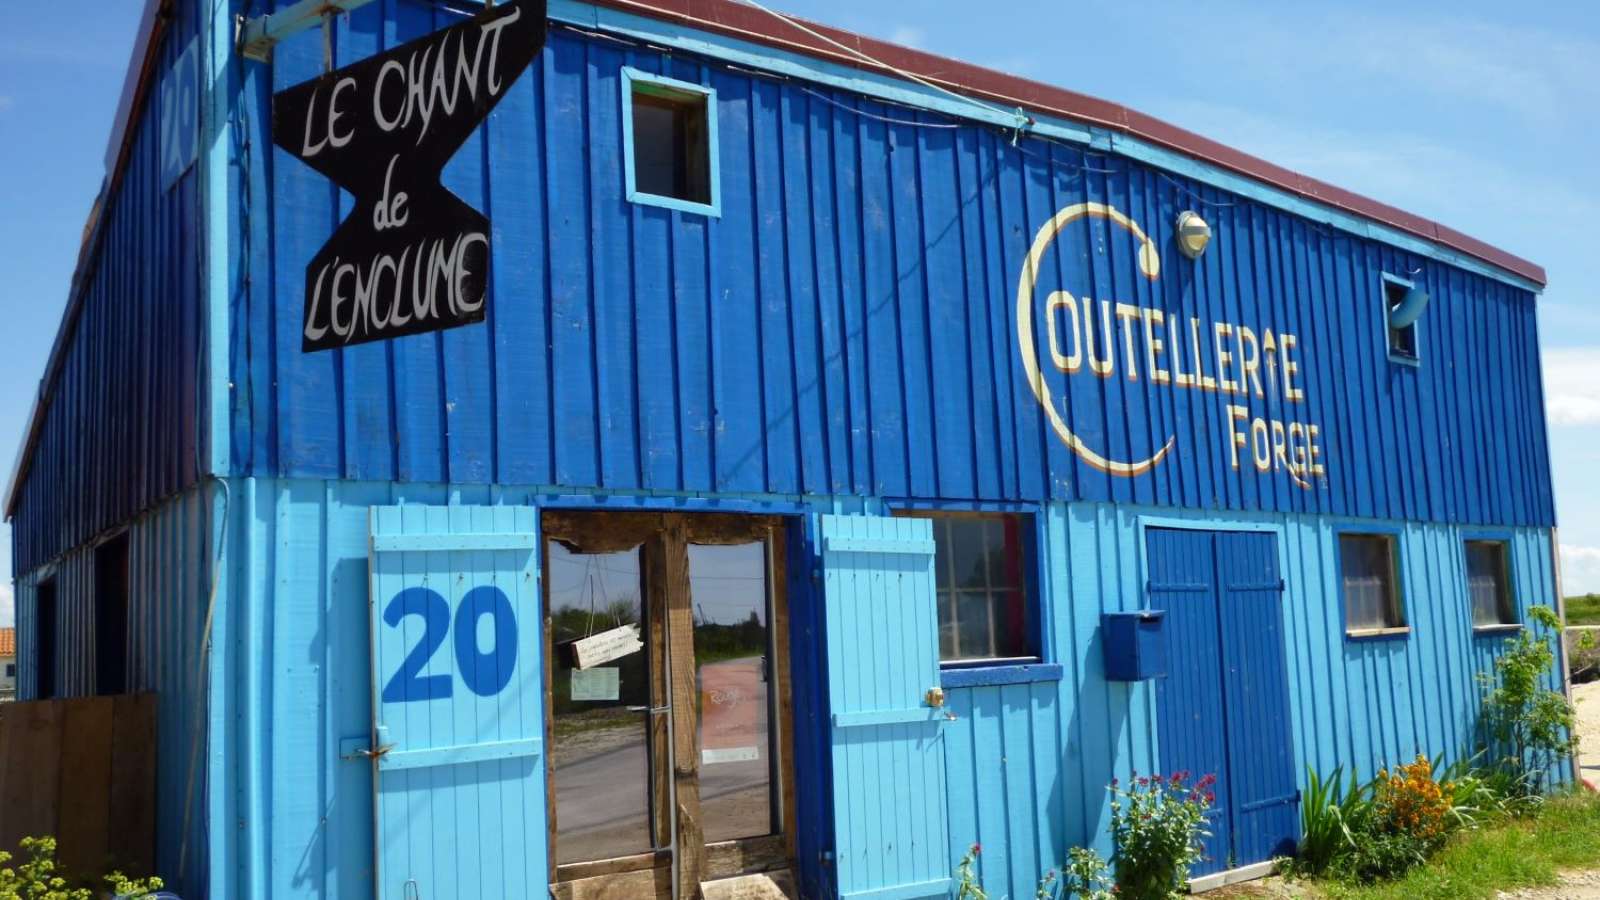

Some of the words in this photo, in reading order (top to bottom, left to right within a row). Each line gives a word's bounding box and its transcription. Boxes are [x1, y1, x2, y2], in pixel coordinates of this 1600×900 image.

[302, 77, 356, 157] LE
[373, 6, 521, 146] CHANT
[373, 154, 408, 231] de
[304, 232, 488, 342] L'ENCLUME
[1017, 201, 1304, 477] COUTELLERIE
[1226, 404, 1324, 489] FORGE
[382, 585, 519, 703] 20
